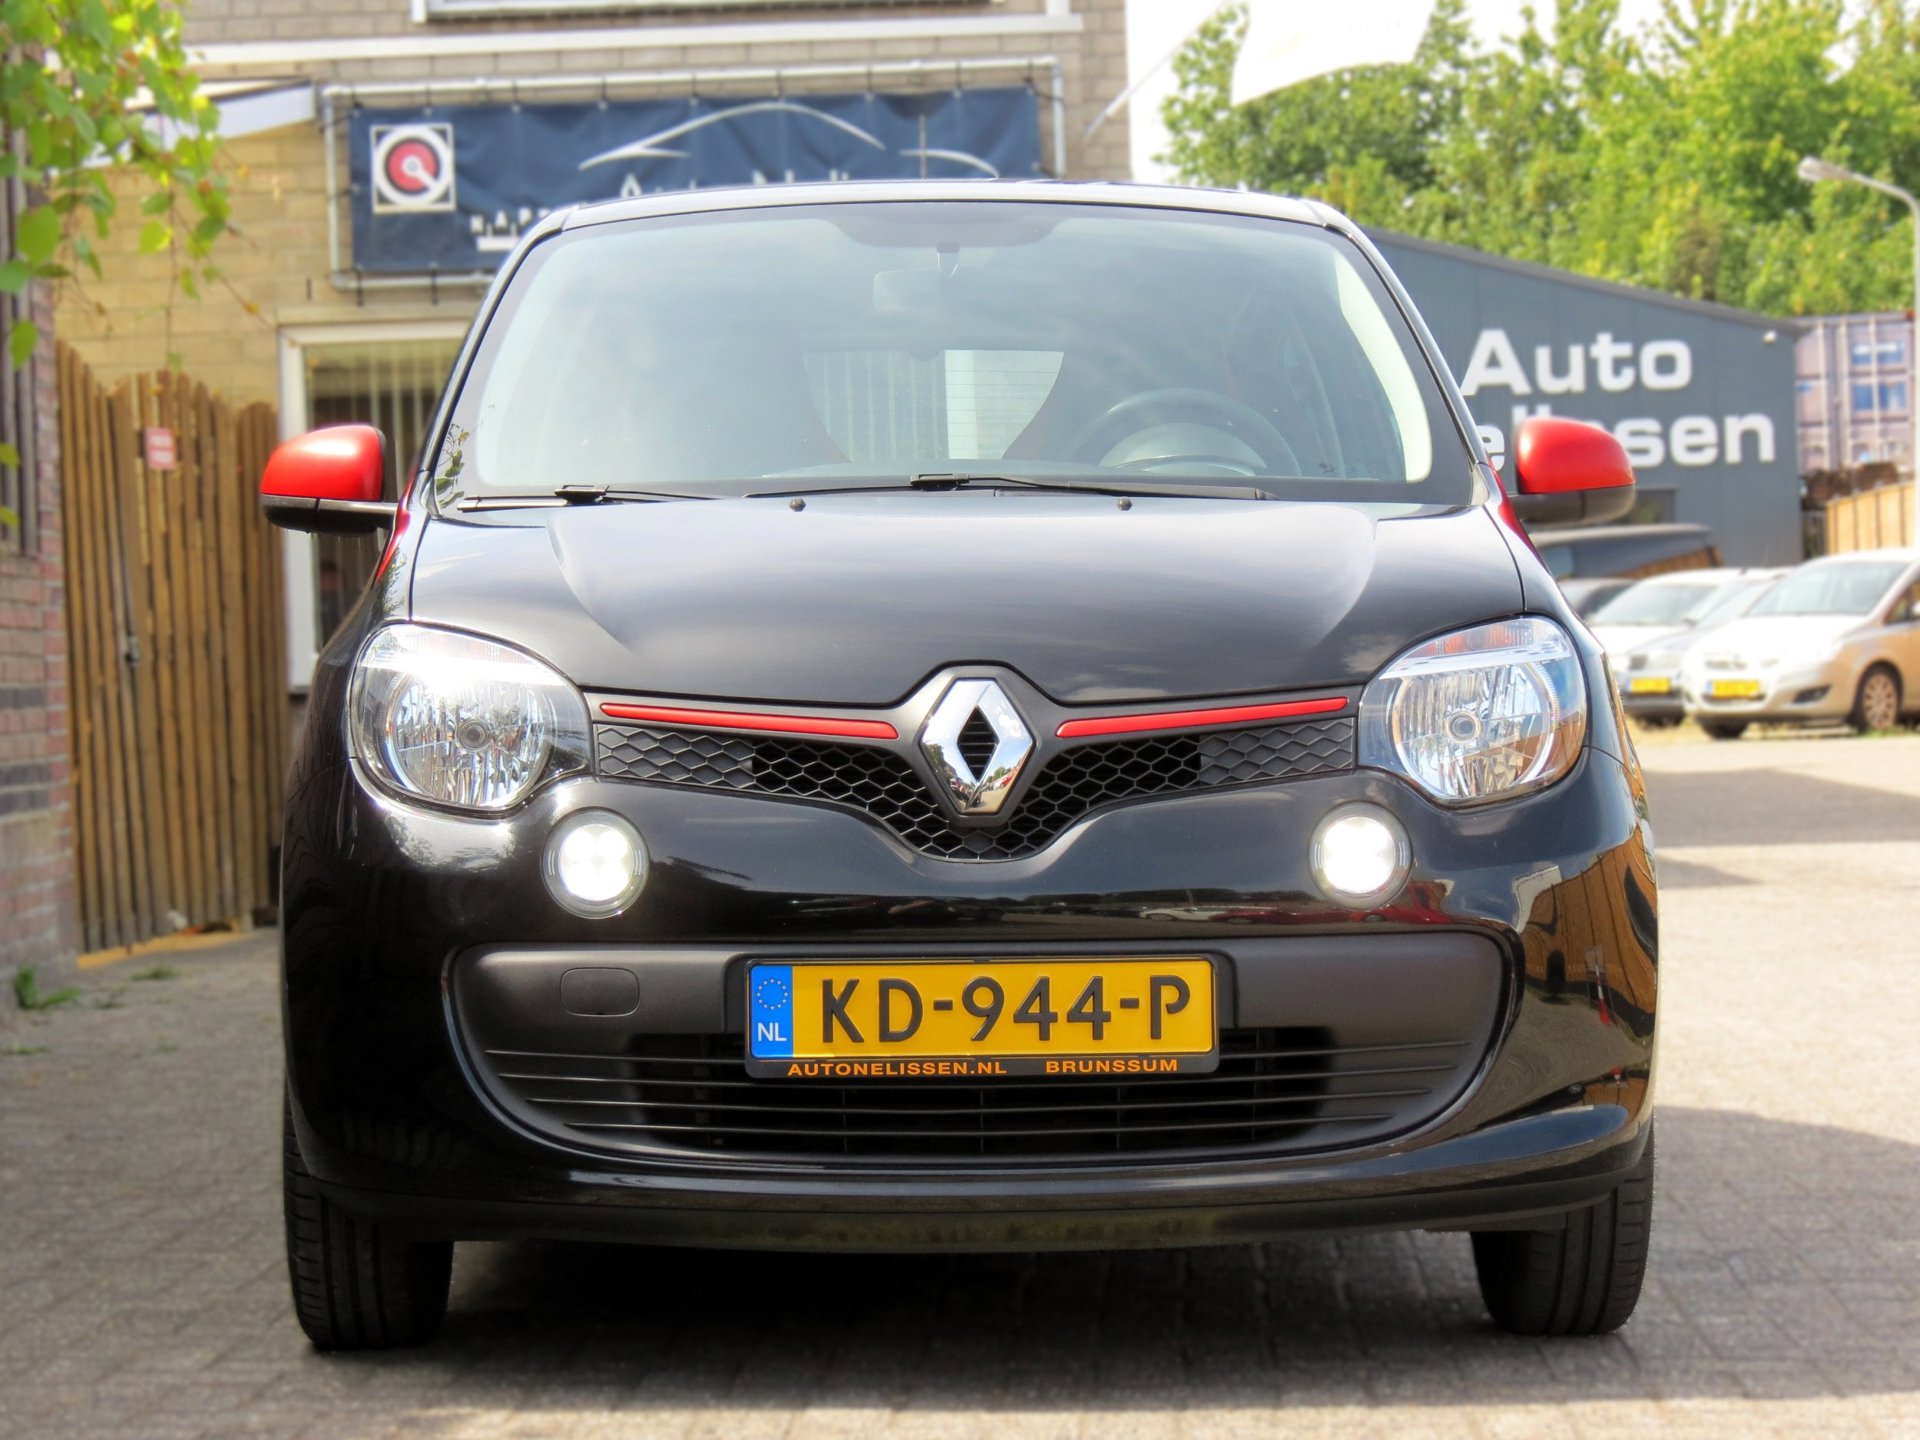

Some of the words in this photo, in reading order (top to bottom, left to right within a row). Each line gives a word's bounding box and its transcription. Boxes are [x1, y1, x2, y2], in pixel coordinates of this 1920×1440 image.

[1461, 328, 1692, 396] Auto
[822, 975, 1191, 1043] KD-944-P
[757, 1023, 787, 1042] NL
[787, 1061, 1007, 1076] AUTONELISSEN.NL
[1046, 1059, 1178, 1073] BRUNSSUM
